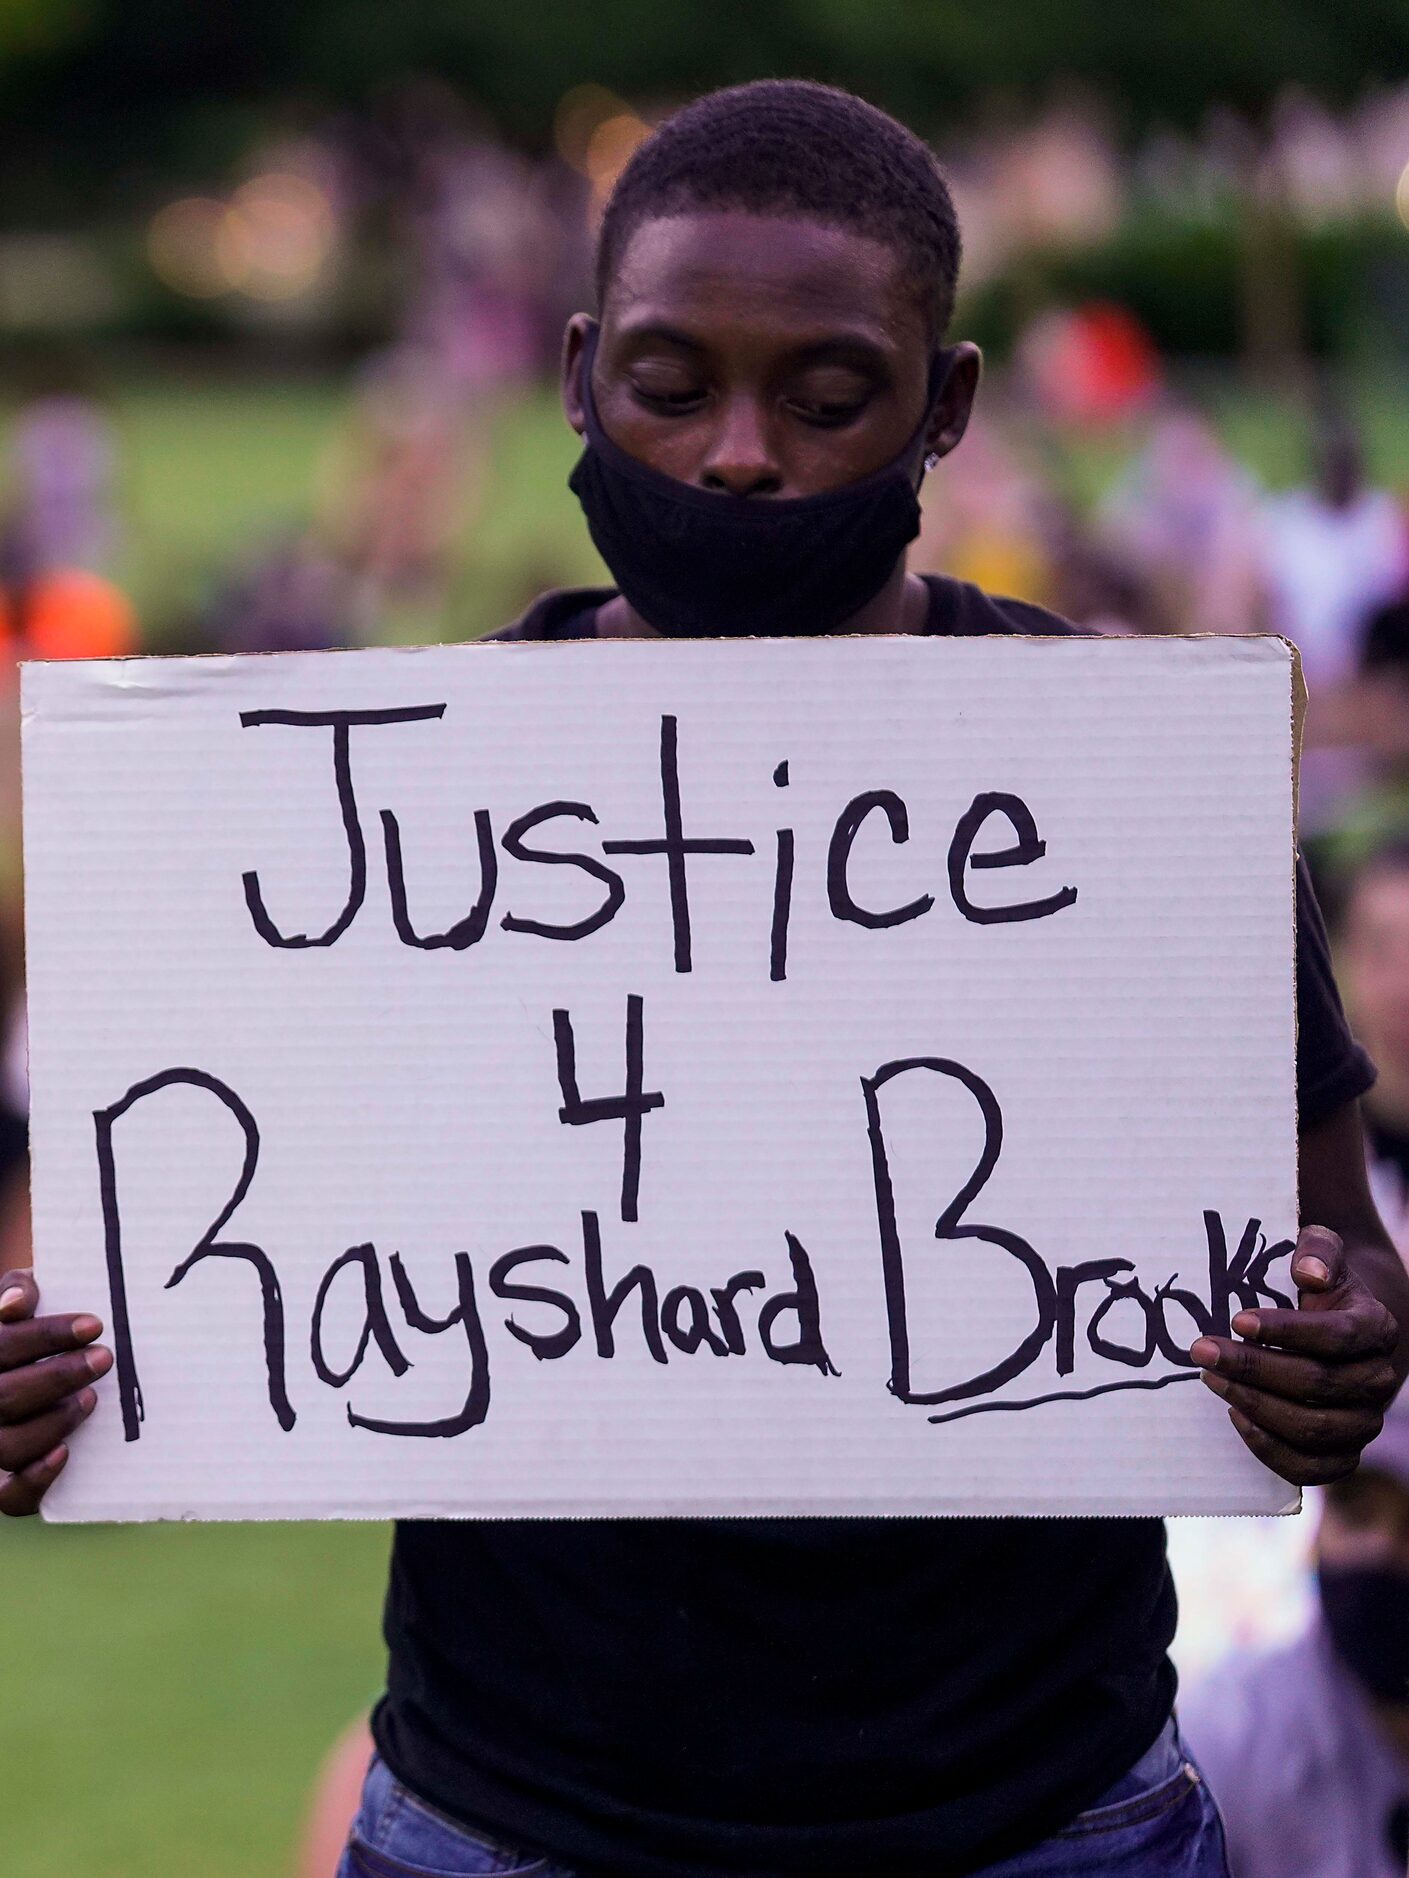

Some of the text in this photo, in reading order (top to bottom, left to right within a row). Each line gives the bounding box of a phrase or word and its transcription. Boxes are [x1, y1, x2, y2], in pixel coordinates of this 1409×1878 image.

[239, 703, 1078, 982] Justice
[553, 995, 665, 1223] 4
[92, 1056, 1296, 1443] Rayshard Brooks
